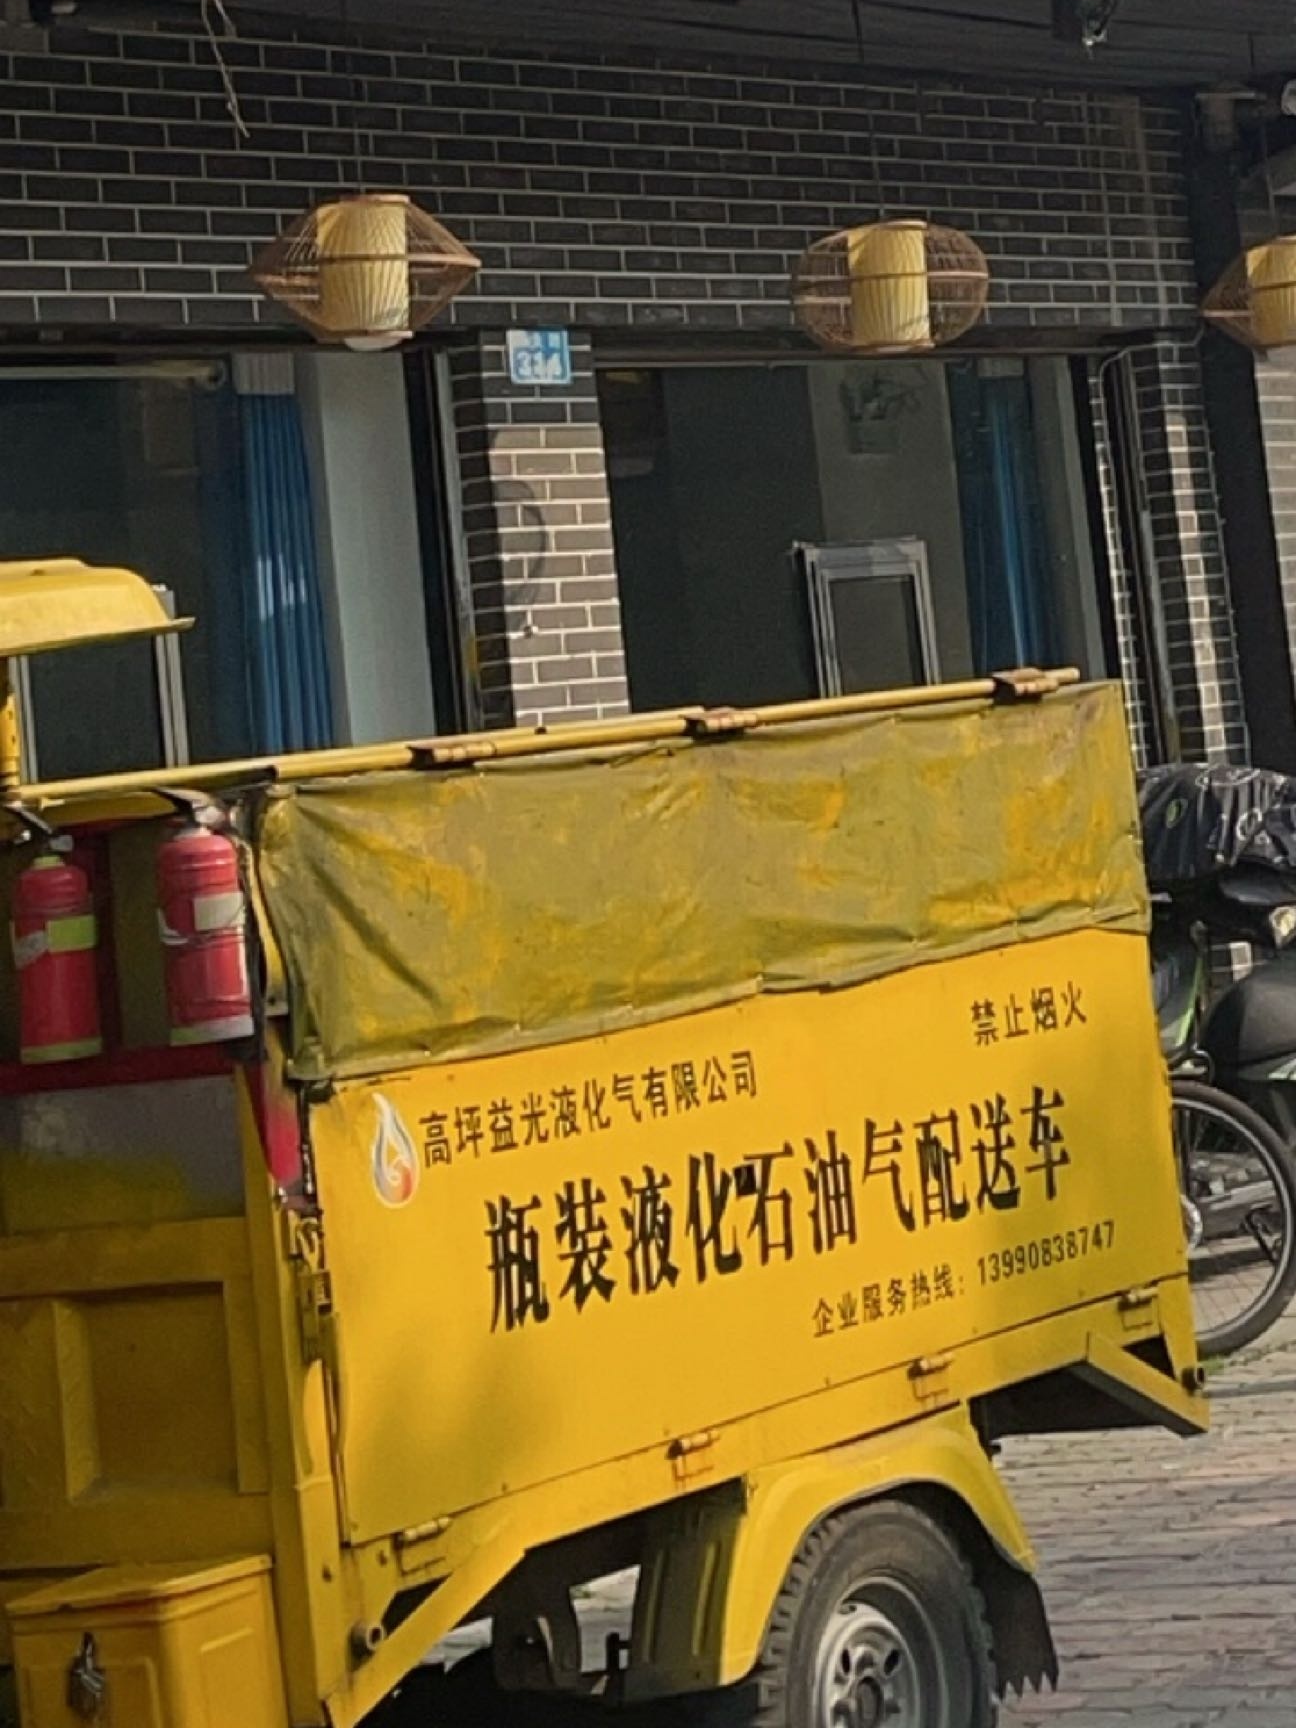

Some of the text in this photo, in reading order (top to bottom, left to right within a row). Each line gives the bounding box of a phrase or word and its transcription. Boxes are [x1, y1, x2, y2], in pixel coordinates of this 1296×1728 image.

[970, 980, 1088, 1047] 禁止烟火
[418, 1049, 758, 1169] 高坪益光液化气有限公司
[483, 1085, 1072, 1335] 瓶装液化石油气配送车
